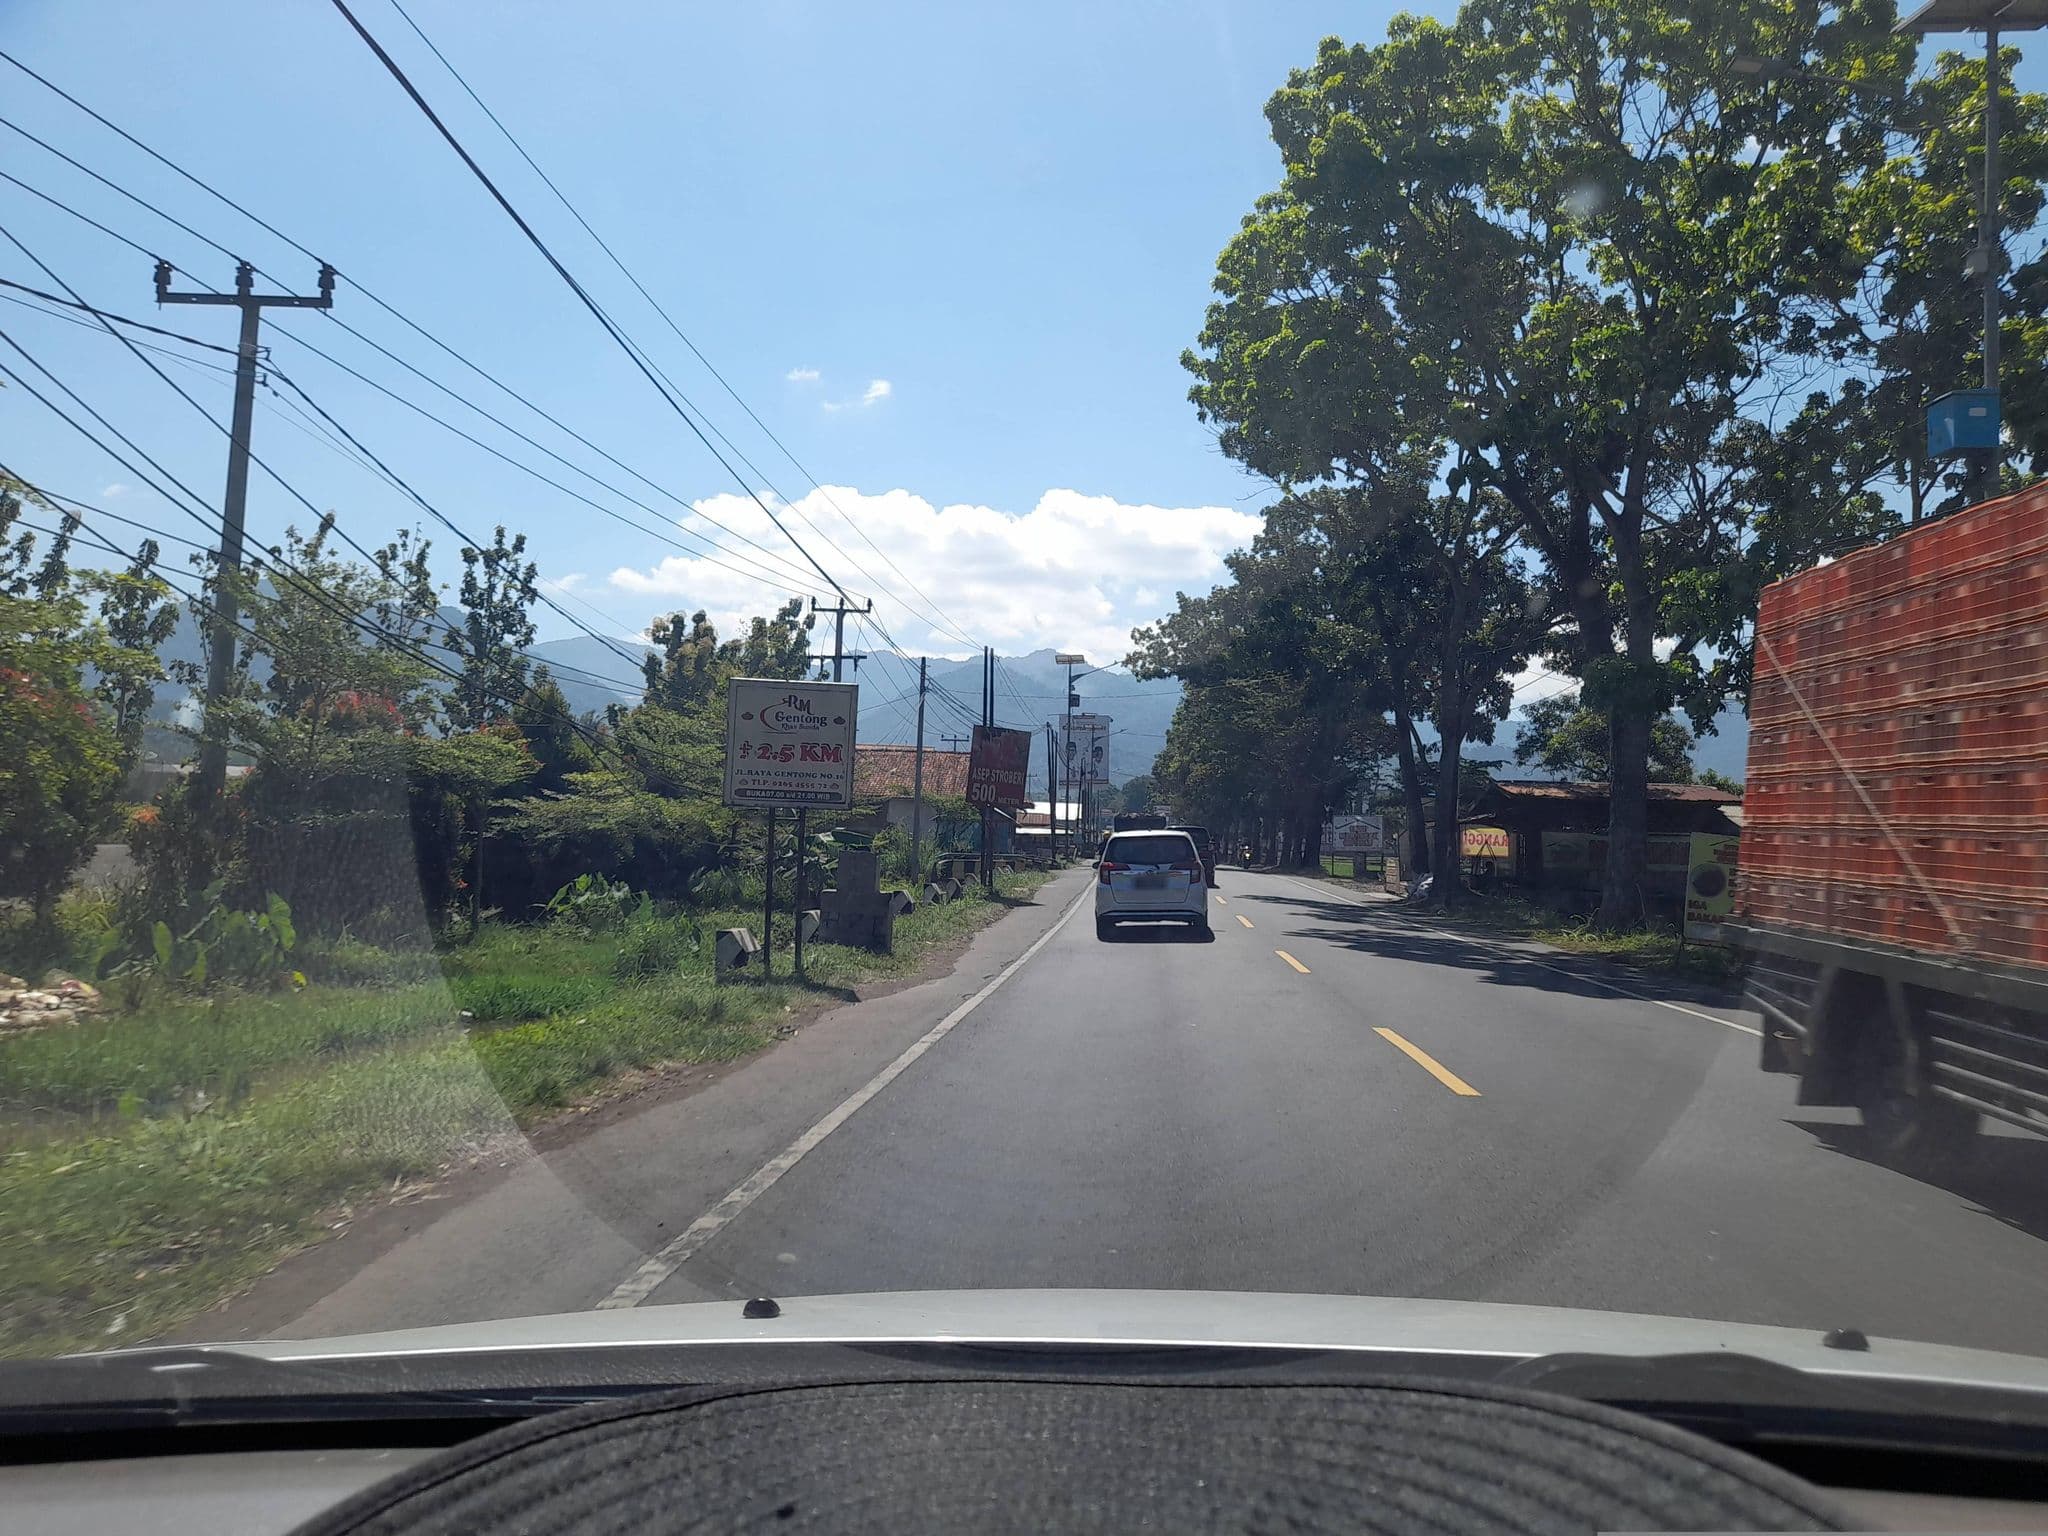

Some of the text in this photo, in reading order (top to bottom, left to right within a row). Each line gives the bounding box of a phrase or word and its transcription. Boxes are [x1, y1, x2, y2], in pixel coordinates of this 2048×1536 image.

[775, 711, 828, 727] Gentong
[756, 743, 796, 763] 2.5
[799, 742, 843, 763] KM
[774, 771, 818, 779] GENTONG
[972, 767, 1025, 785] ASEP STROBERI
[971, 782, 996, 802] 500
